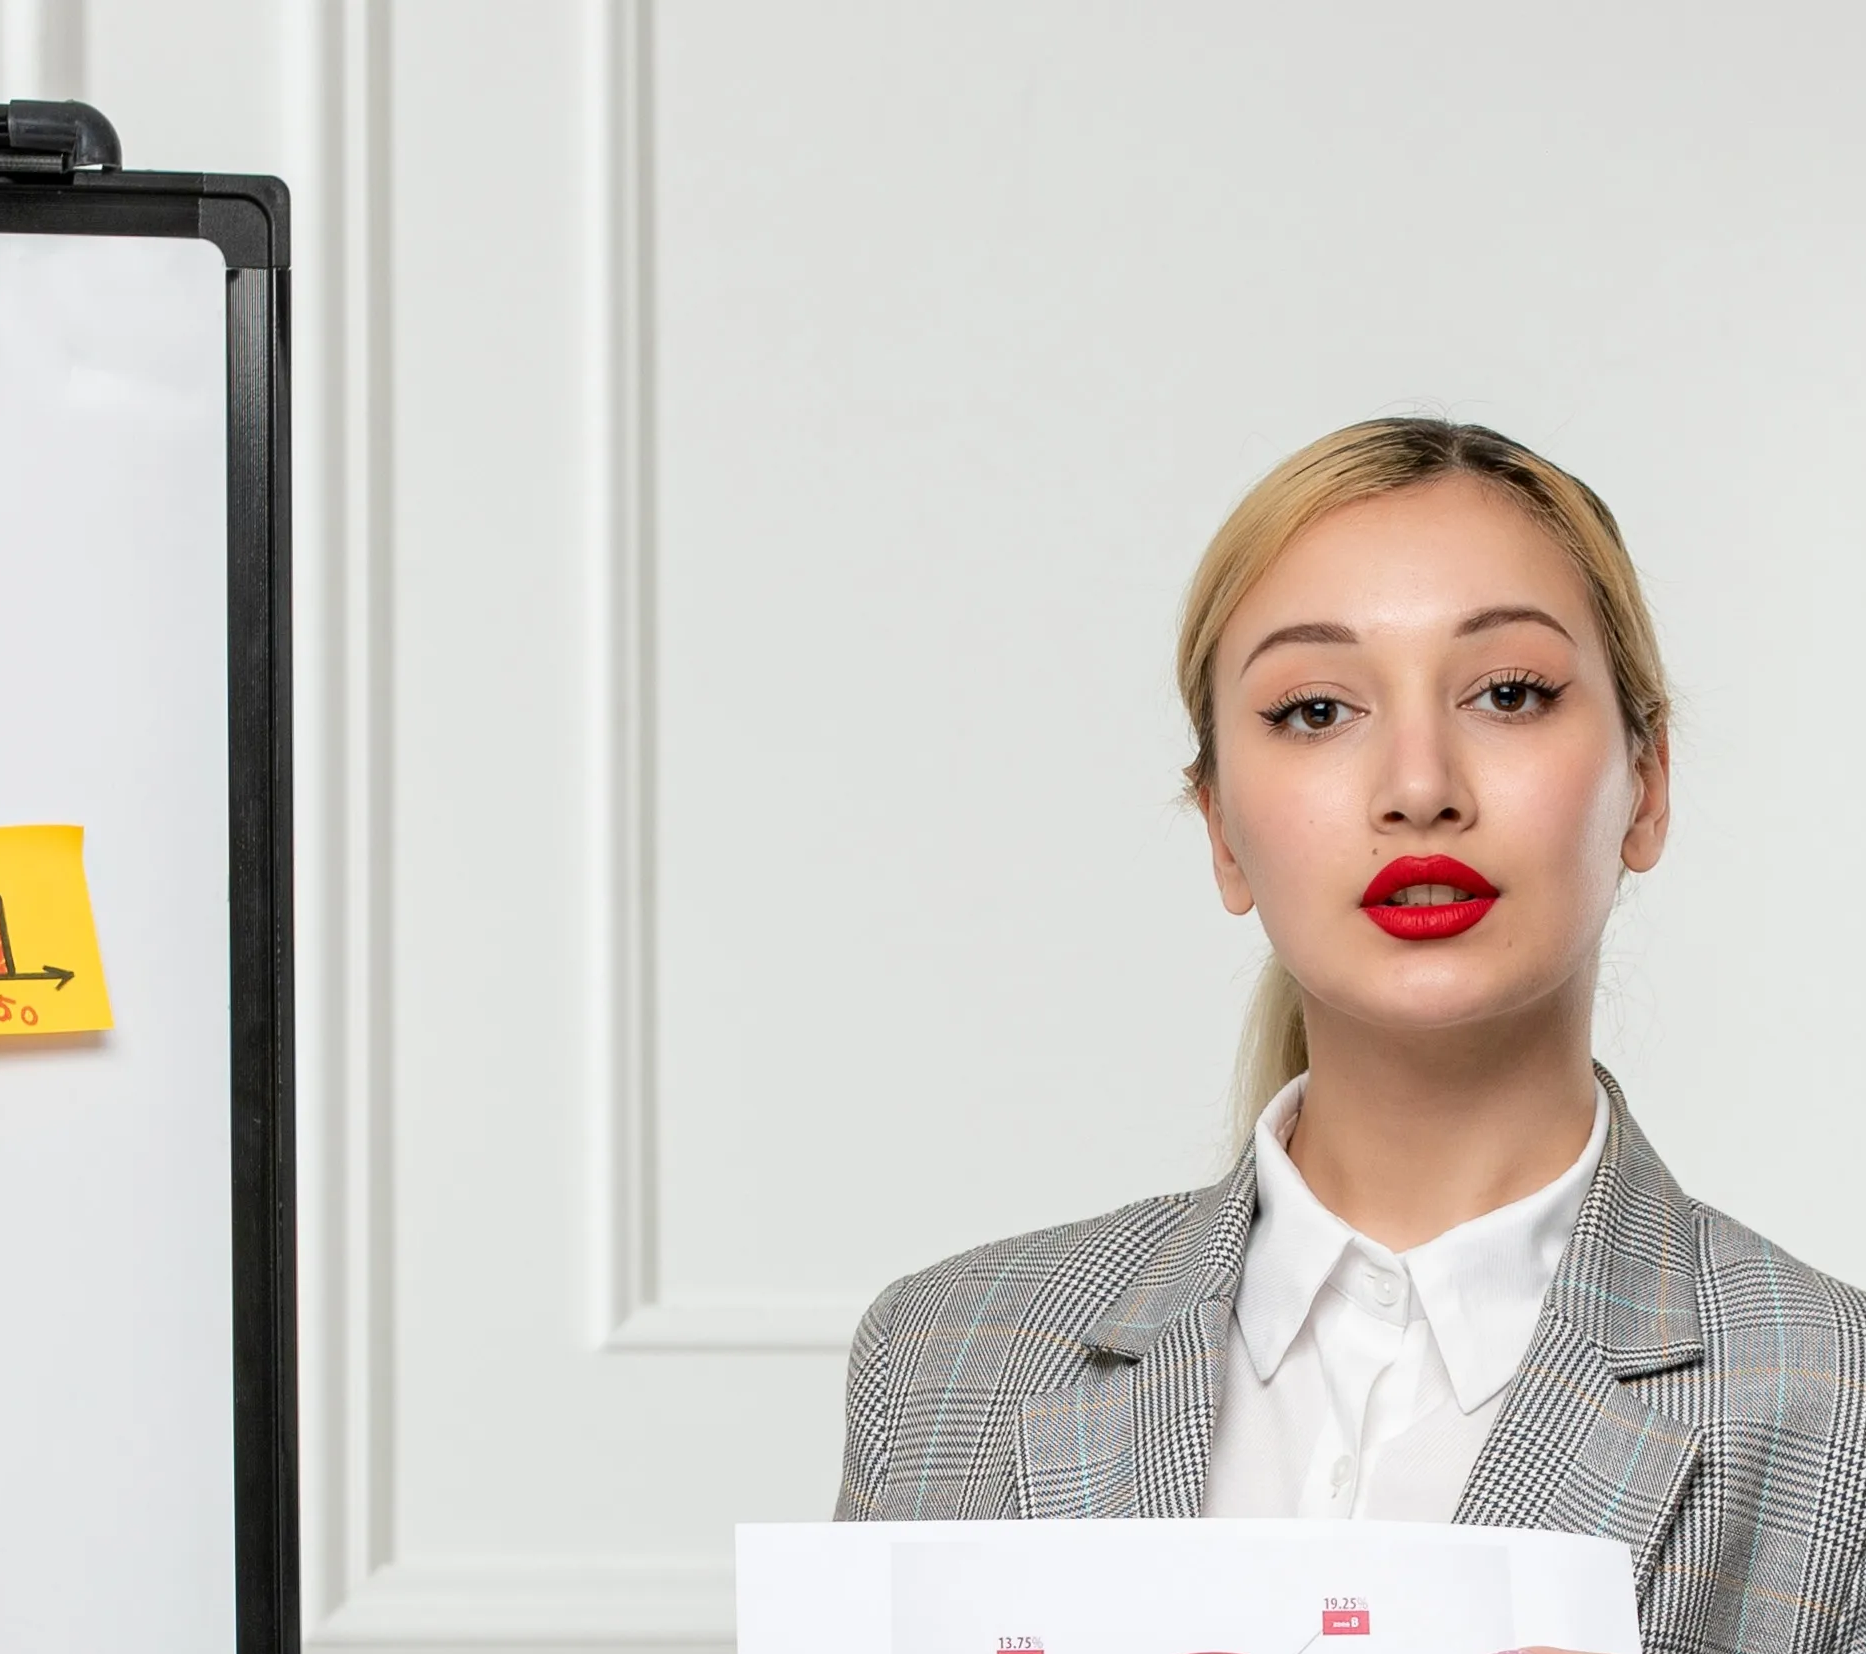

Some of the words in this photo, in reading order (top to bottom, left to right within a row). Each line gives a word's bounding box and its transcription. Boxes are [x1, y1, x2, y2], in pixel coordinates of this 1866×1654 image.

[1324, 1597, 1368, 1609] 19.25%
[1351, 1617, 1359, 1628] B
[999, 1637, 1043, 1648] 13.75%
